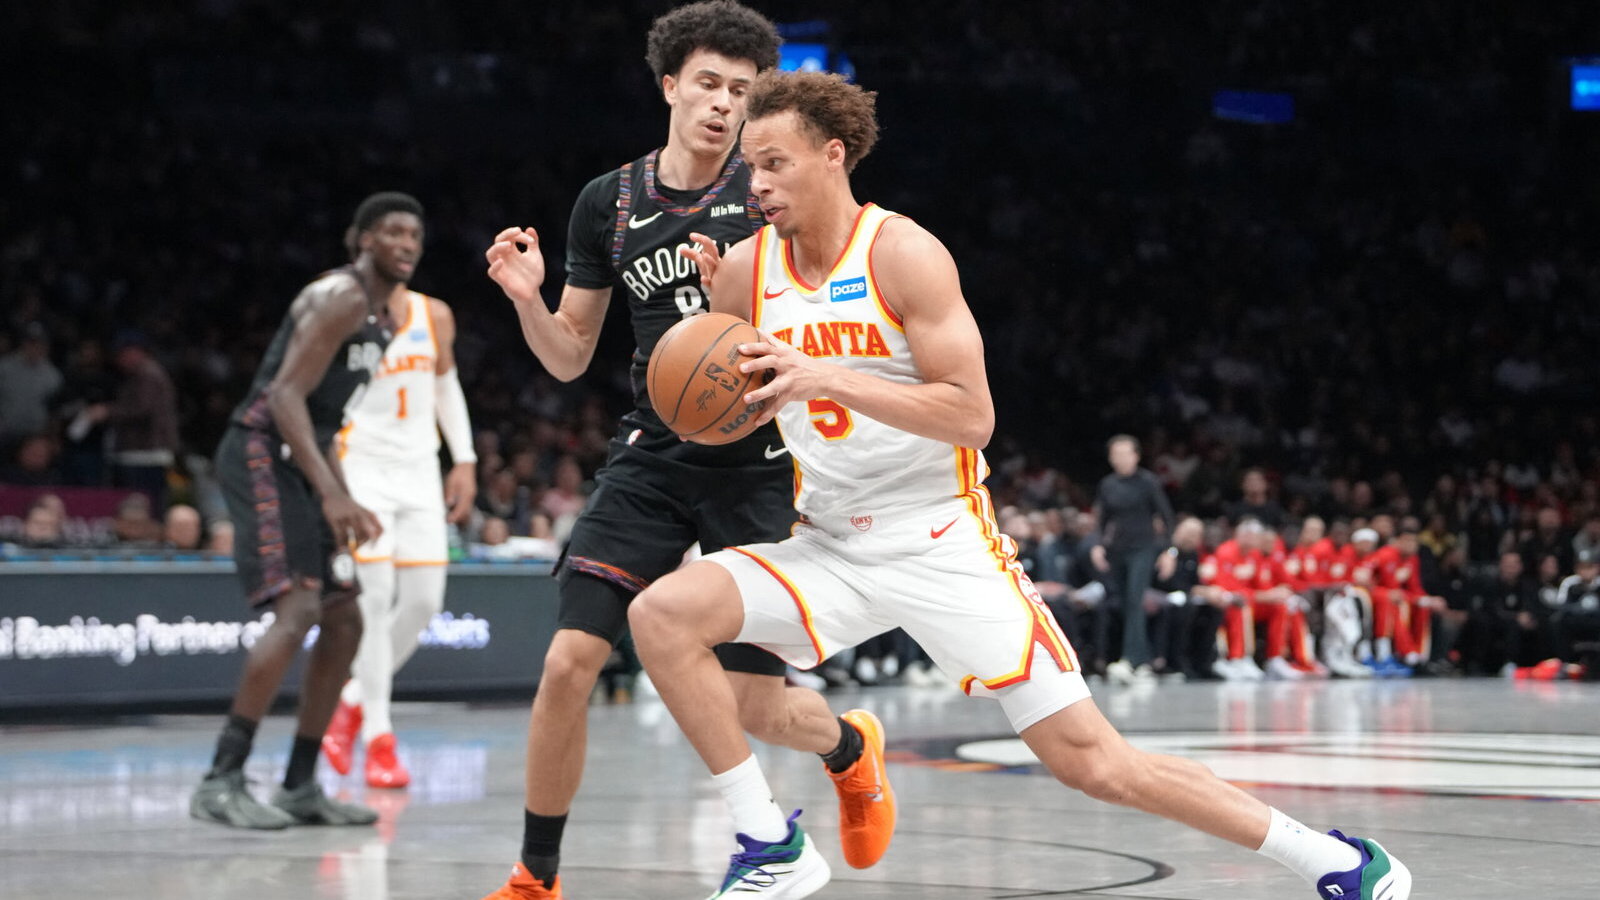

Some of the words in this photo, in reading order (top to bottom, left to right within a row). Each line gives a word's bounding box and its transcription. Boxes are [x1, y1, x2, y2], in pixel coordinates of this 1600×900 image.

[710, 206, 720, 218] All
[727, 203, 744, 215] Won
[831, 281, 866, 299] paze
[396, 387, 408, 420] 1
[806, 397, 854, 441] 5
[14, 615, 136, 667] Banking
[136, 613, 243, 656] Partner
